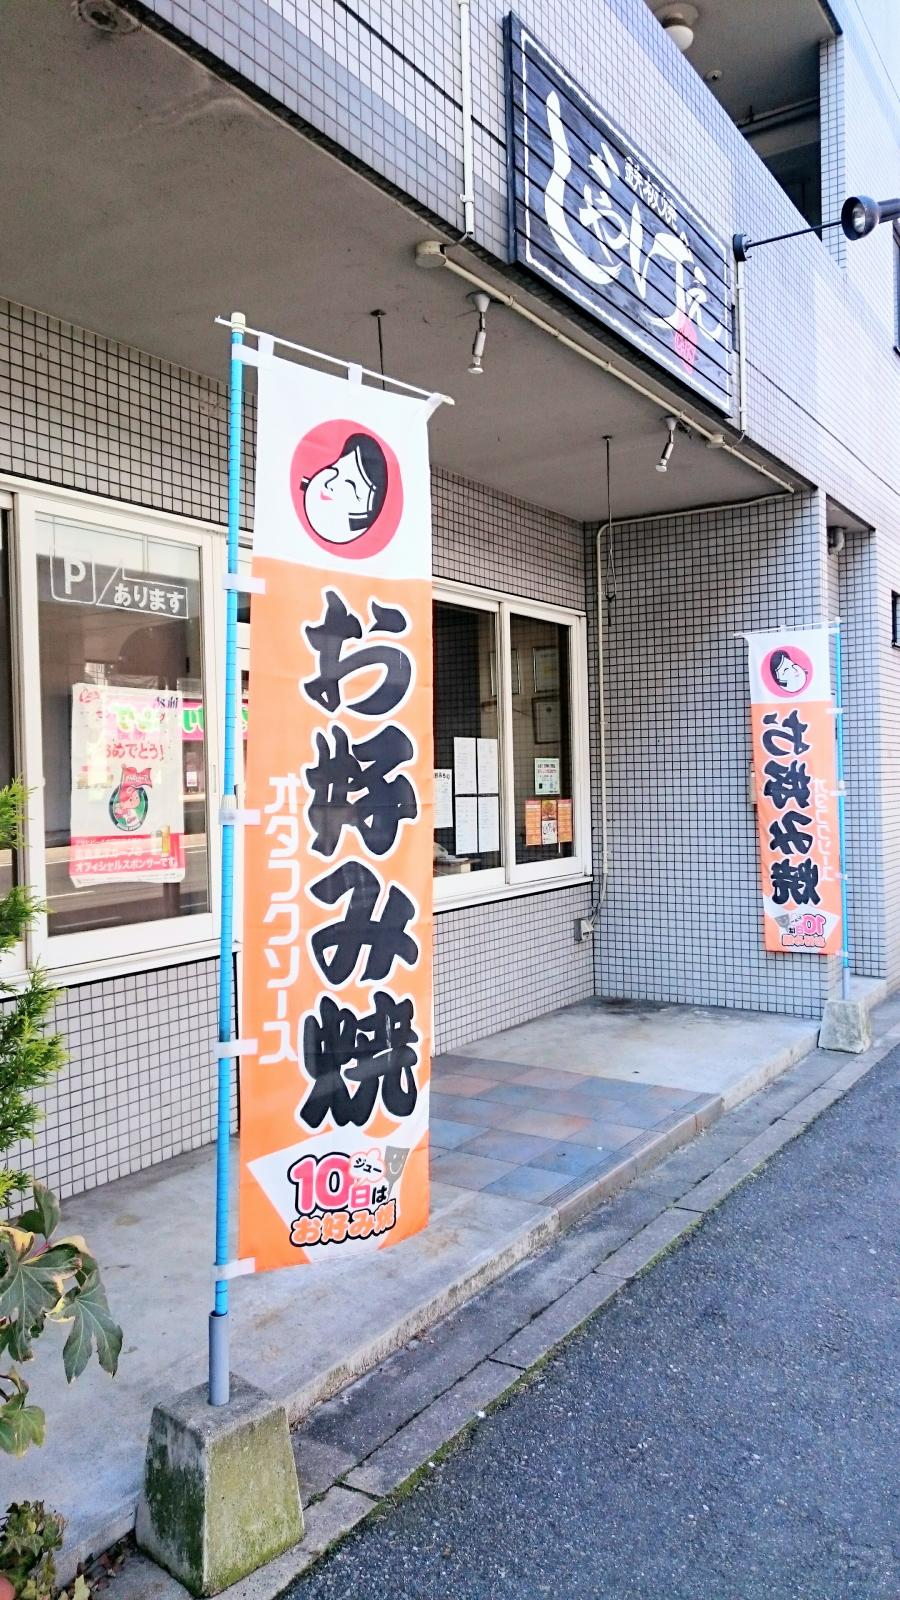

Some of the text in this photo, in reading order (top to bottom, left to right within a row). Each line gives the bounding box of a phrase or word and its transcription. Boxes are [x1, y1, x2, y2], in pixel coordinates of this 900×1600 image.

[625, 156, 678, 231] 鉄板焼
[64, 557, 184, 613] P あります
[301, 589, 419, 1128] お好み焼
[259, 773, 300, 1064] オタフクソース
[353, 1157, 382, 1173] ジュー
